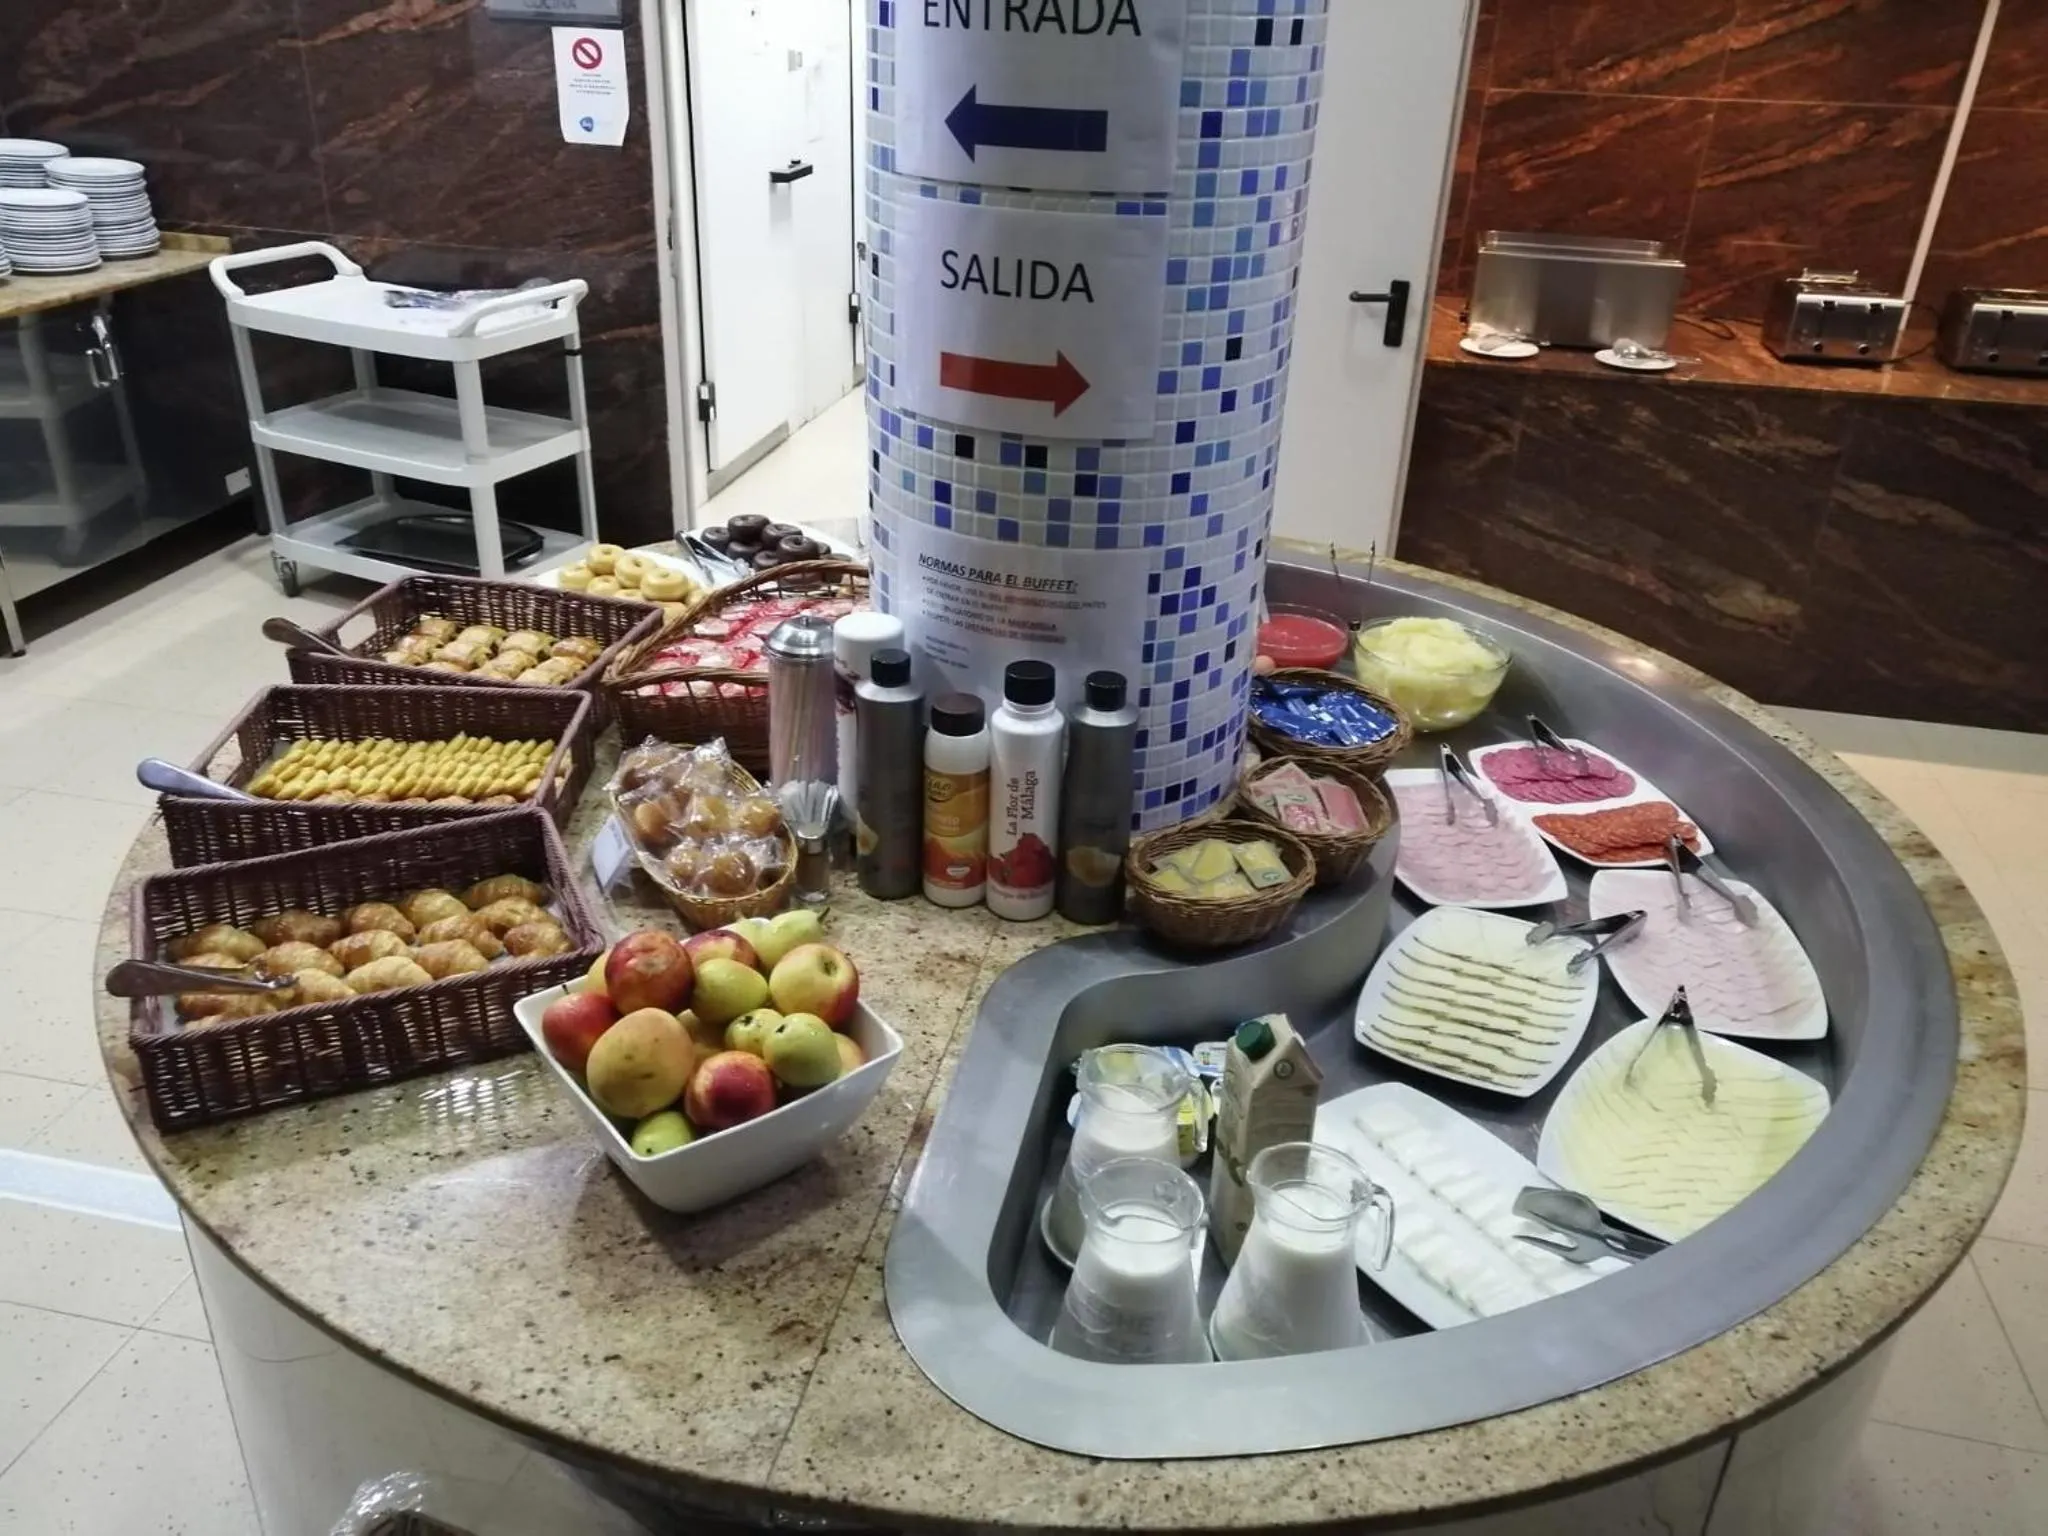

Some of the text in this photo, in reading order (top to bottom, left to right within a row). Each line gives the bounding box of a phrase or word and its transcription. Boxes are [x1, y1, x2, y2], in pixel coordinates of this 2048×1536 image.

[923, 0, 1143, 37] ENTRADA
[940, 250, 1095, 304] SALIDA
[918, 553, 1079, 592] NORMAS PARA EL BUFFET:
[1006, 777, 1020, 836] La Flor de
[1021, 770, 1039, 821] Málaga
